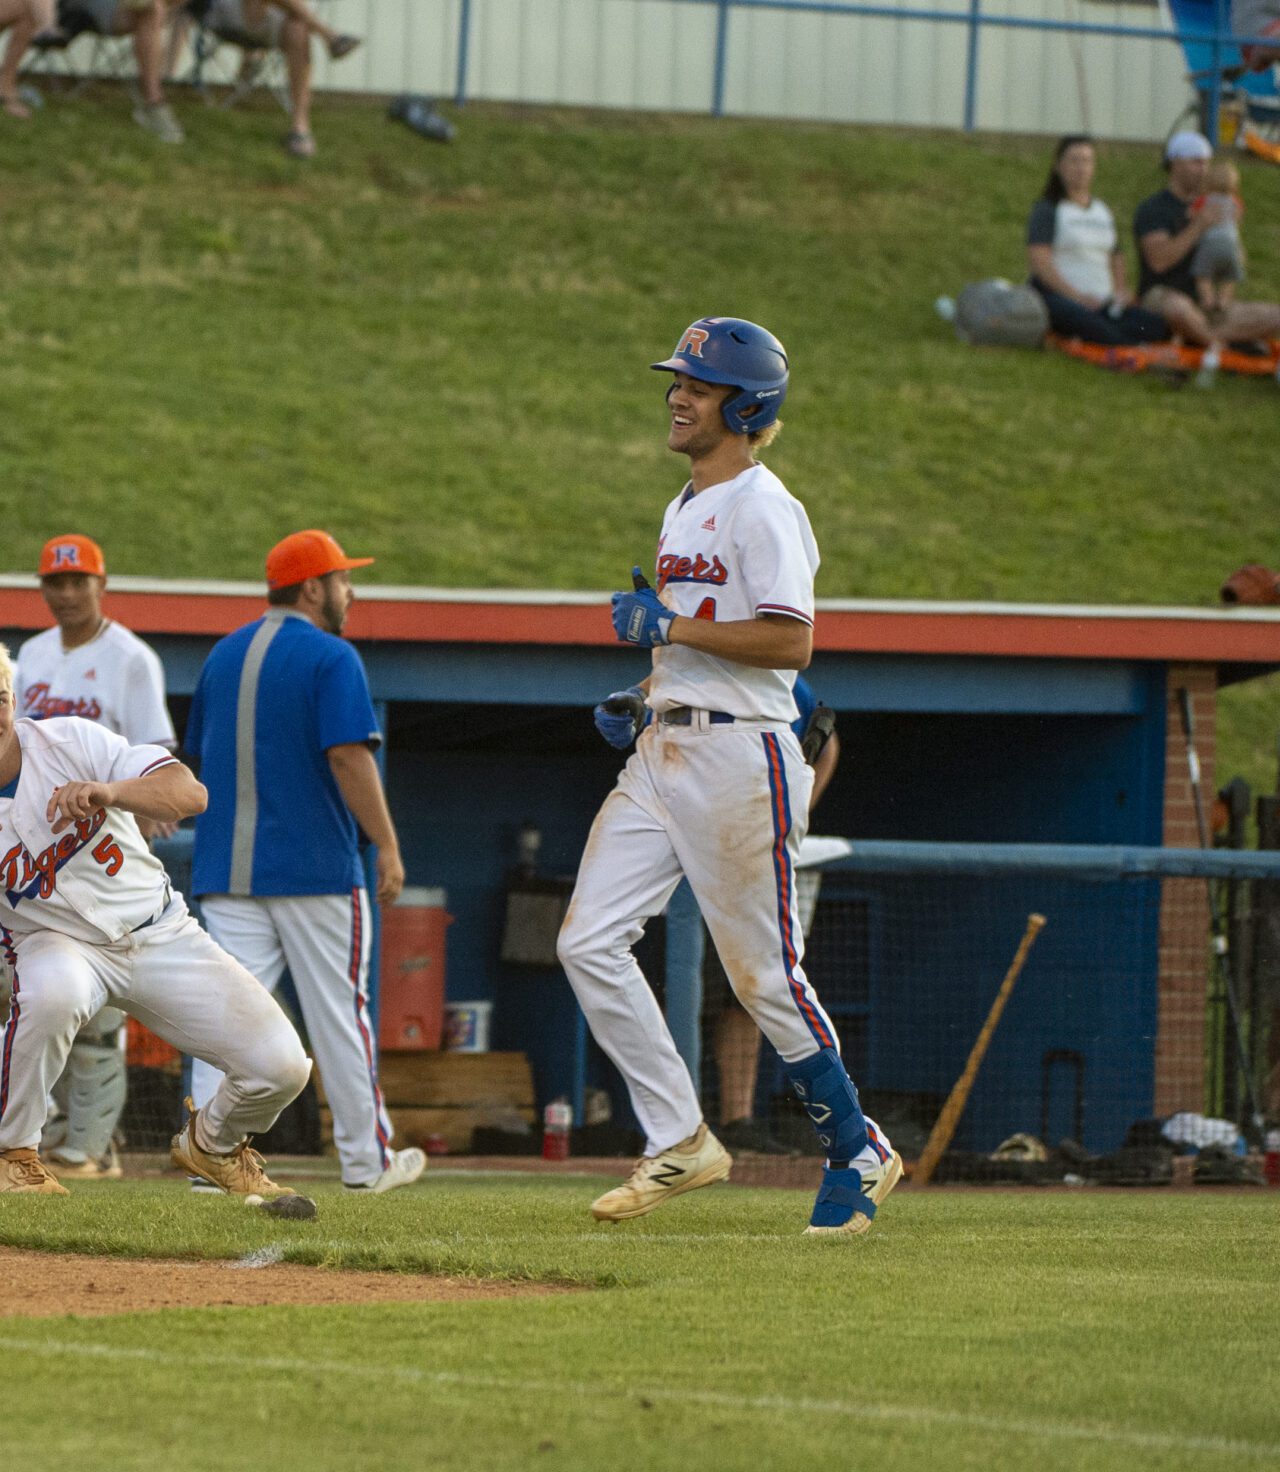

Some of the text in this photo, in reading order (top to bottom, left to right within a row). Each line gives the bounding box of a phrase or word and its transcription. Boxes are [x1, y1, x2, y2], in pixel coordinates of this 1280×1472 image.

[677, 328, 709, 358] R
[51, 543, 81, 569] R
[656, 534, 729, 597] gers
[24, 683, 102, 720] Tigers
[91, 833, 124, 877] 5
